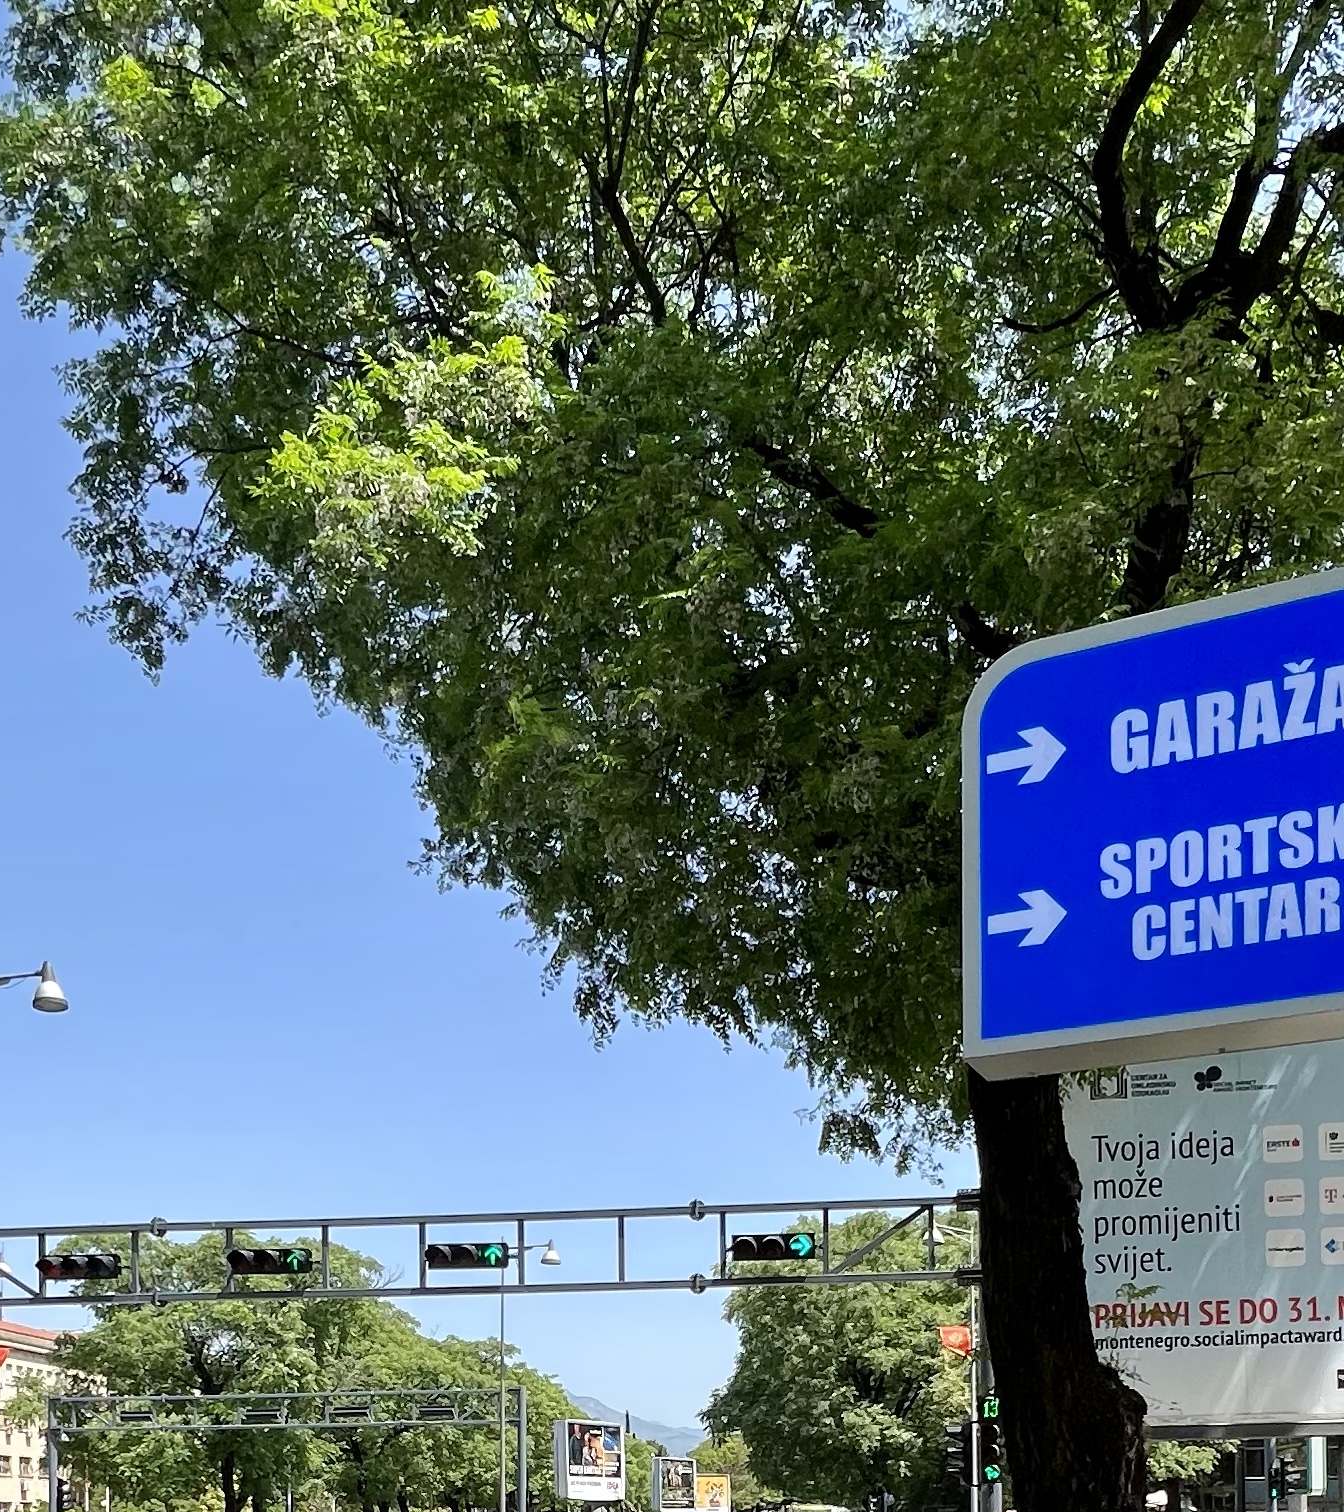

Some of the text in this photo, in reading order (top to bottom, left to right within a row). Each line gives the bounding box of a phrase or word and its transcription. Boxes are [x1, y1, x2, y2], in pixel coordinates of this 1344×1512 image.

[1133, 877, 1340, 960] CENTAR
[1090, 1130, 1235, 1168] Tvoja ideja
[1093, 1169, 1163, 1200] može
[1094, 1204, 1240, 1244] promijeniti
[1094, 1245, 1172, 1280] svijet.
[1094, 1301, 1189, 1328] PRIJAVI
[1198, 1300, 1230, 1326] SE
[1239, 1298, 1278, 1325] DO
[1288, 1296, 1330, 1322] 31.
[983, 1400, 999, 1418] 13
